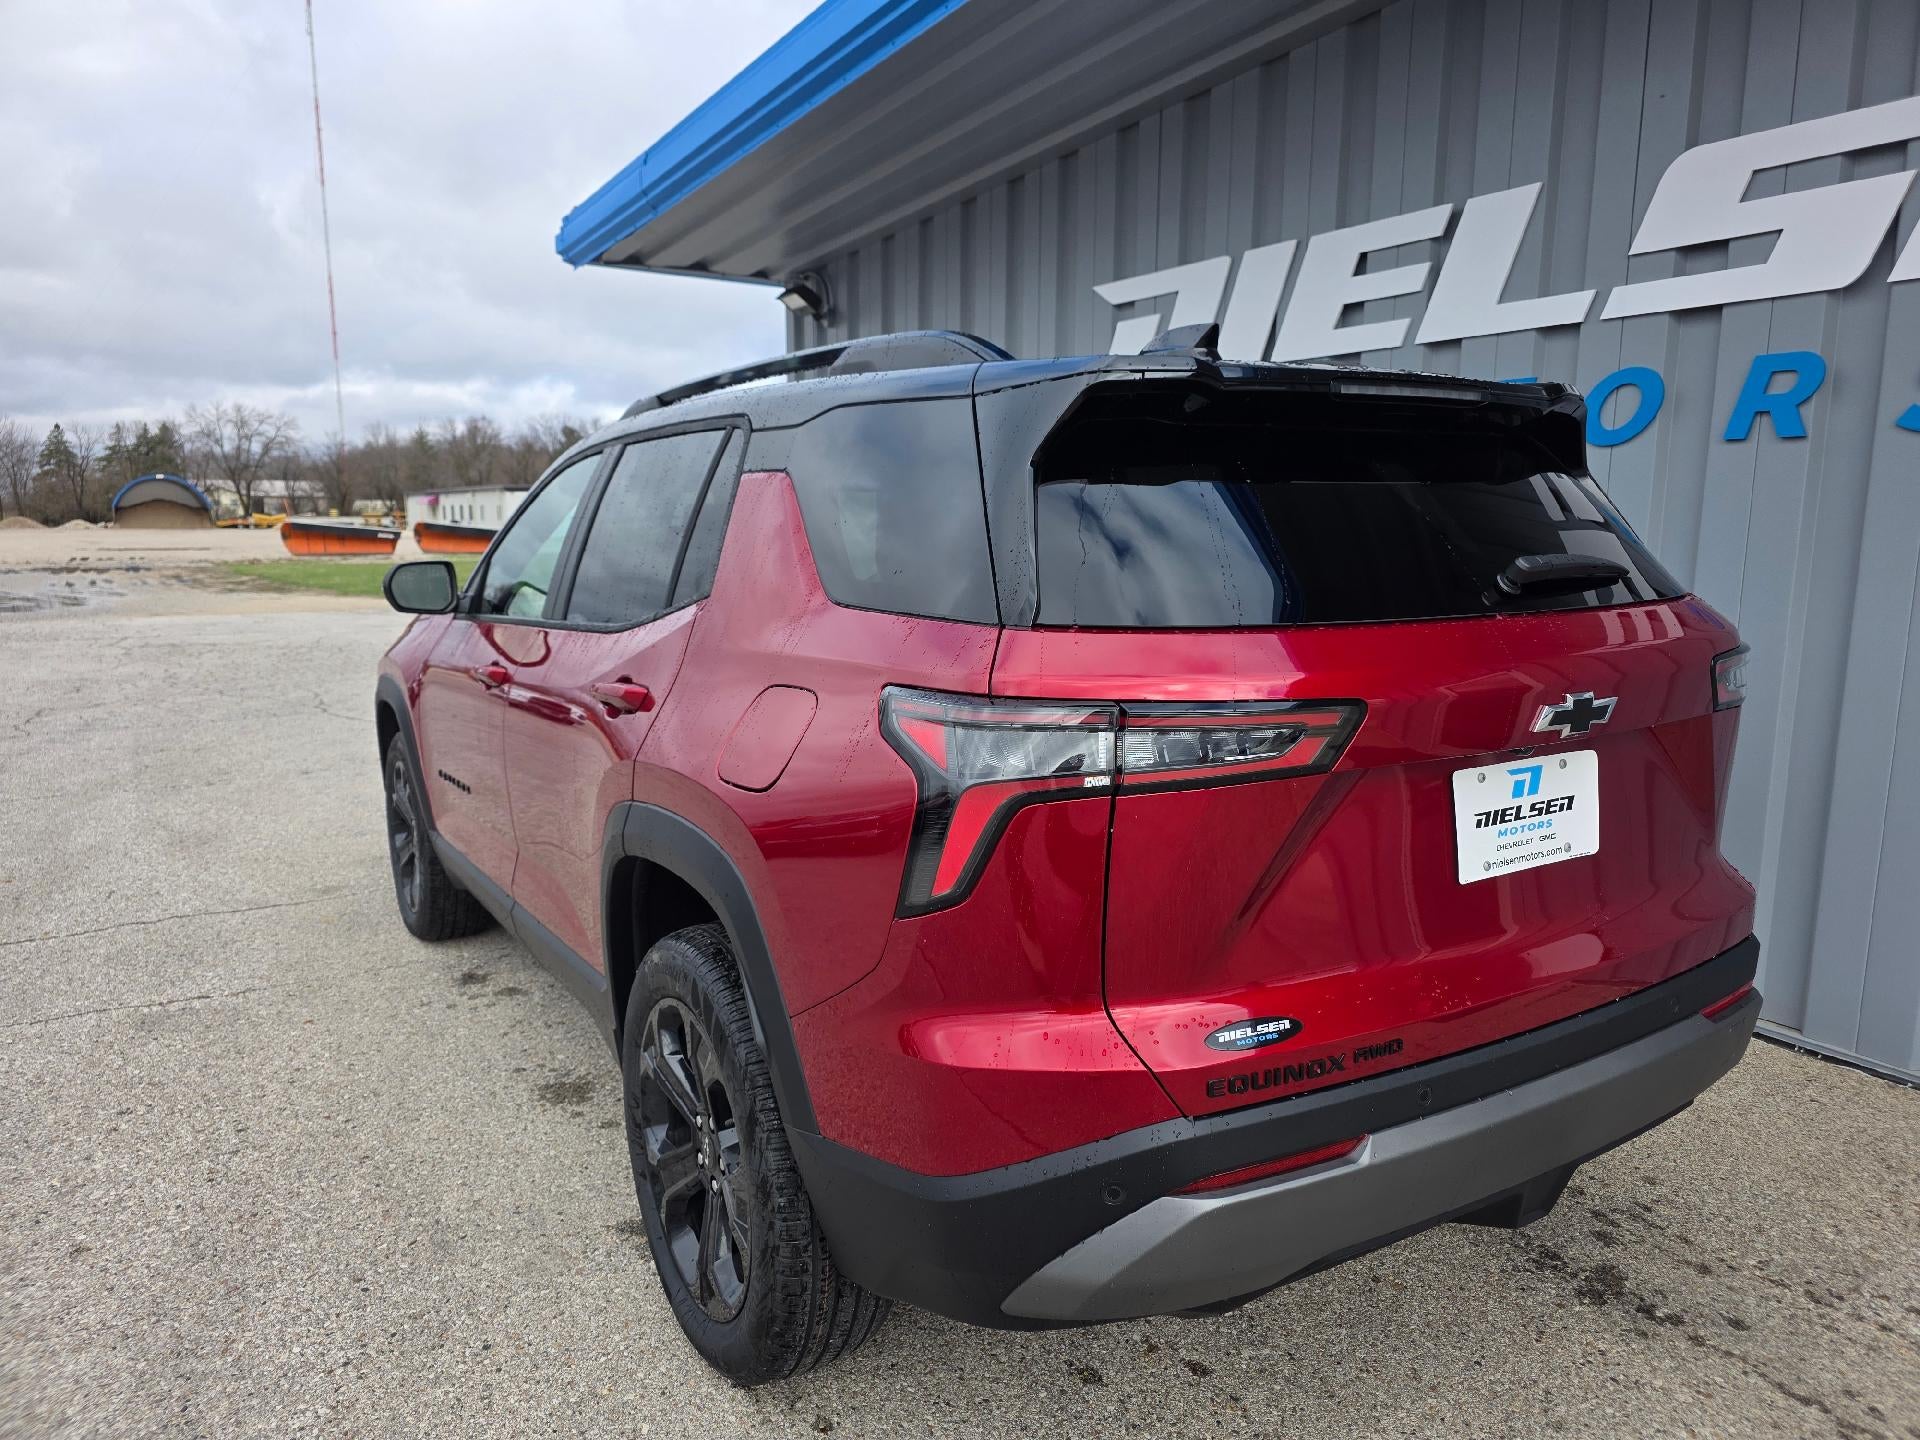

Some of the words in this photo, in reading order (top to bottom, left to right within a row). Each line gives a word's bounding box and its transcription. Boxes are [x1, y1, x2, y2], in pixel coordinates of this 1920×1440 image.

[1093, 95, 1920, 363] NIELS
[1474, 795, 1575, 829] NIELSEN
[1498, 818, 1553, 838] MOTORS
[1496, 837, 1534, 852] CHEVROLET
[1538, 832, 1557, 842] GMC
[1215, 1019, 1292, 1043] NIELSEN
[1236, 1032, 1279, 1047] MOTORS
[1207, 1053, 1346, 1098] EQUINOX
[1353, 1038, 1404, 1064] AWD
